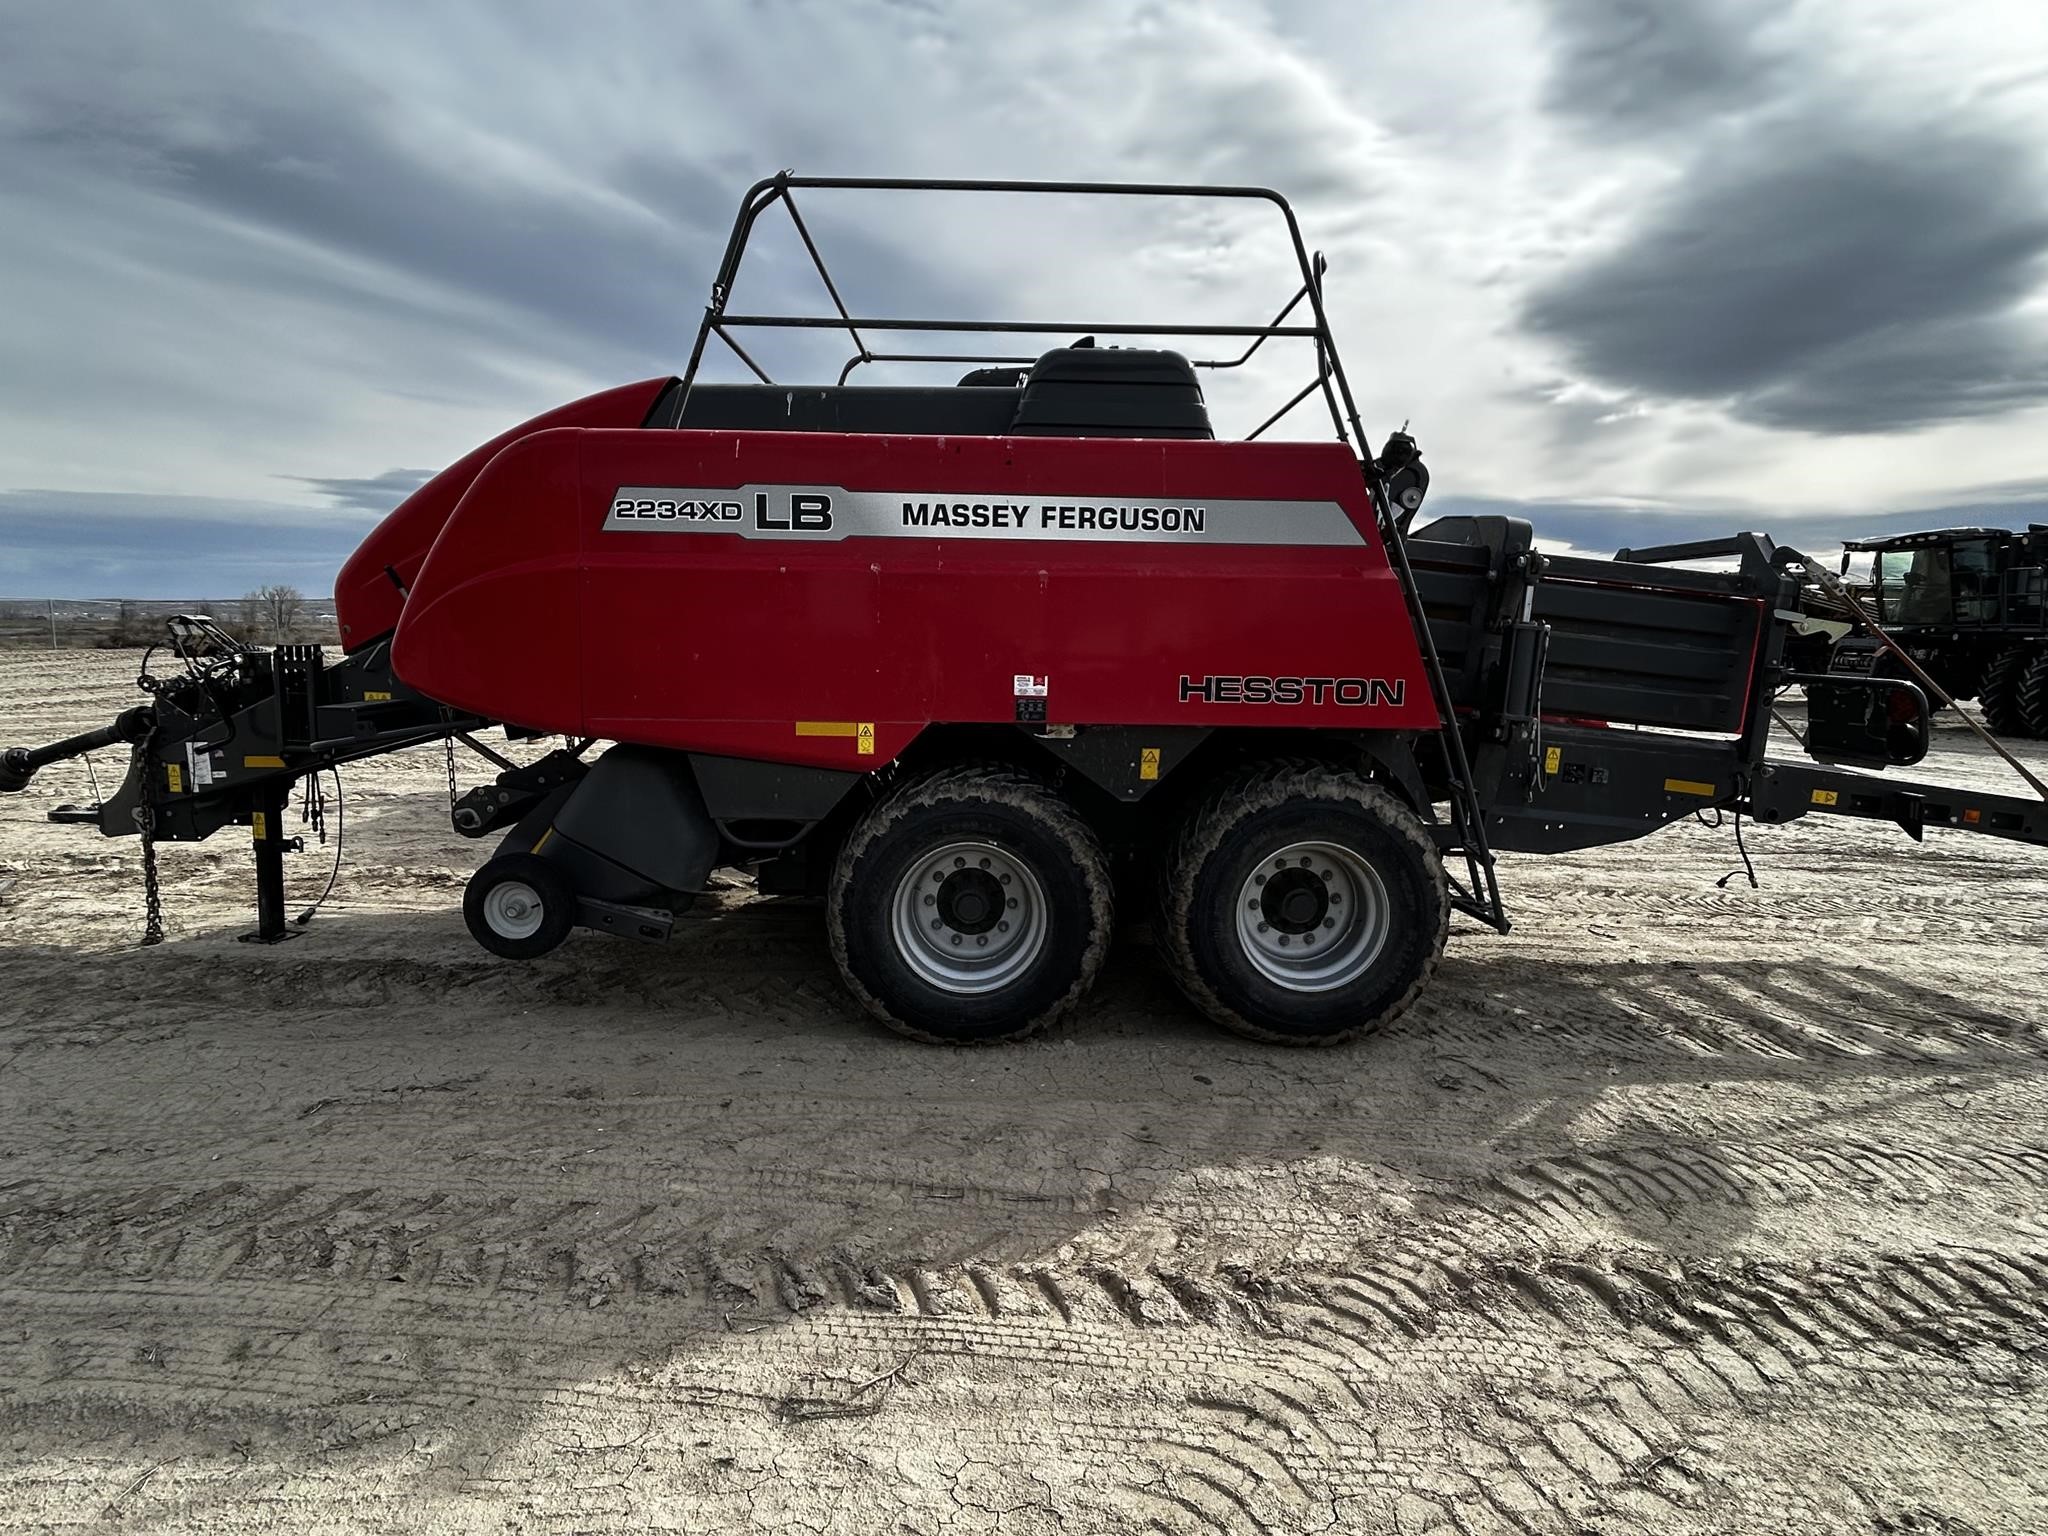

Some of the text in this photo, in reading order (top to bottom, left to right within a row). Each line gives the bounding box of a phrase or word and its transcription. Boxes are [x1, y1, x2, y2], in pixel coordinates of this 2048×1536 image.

[614, 492, 833, 532] 2234XD LB
[901, 502, 1206, 532] MASSEY FERGUSON
[1178, 674, 1406, 707] HESSTON
